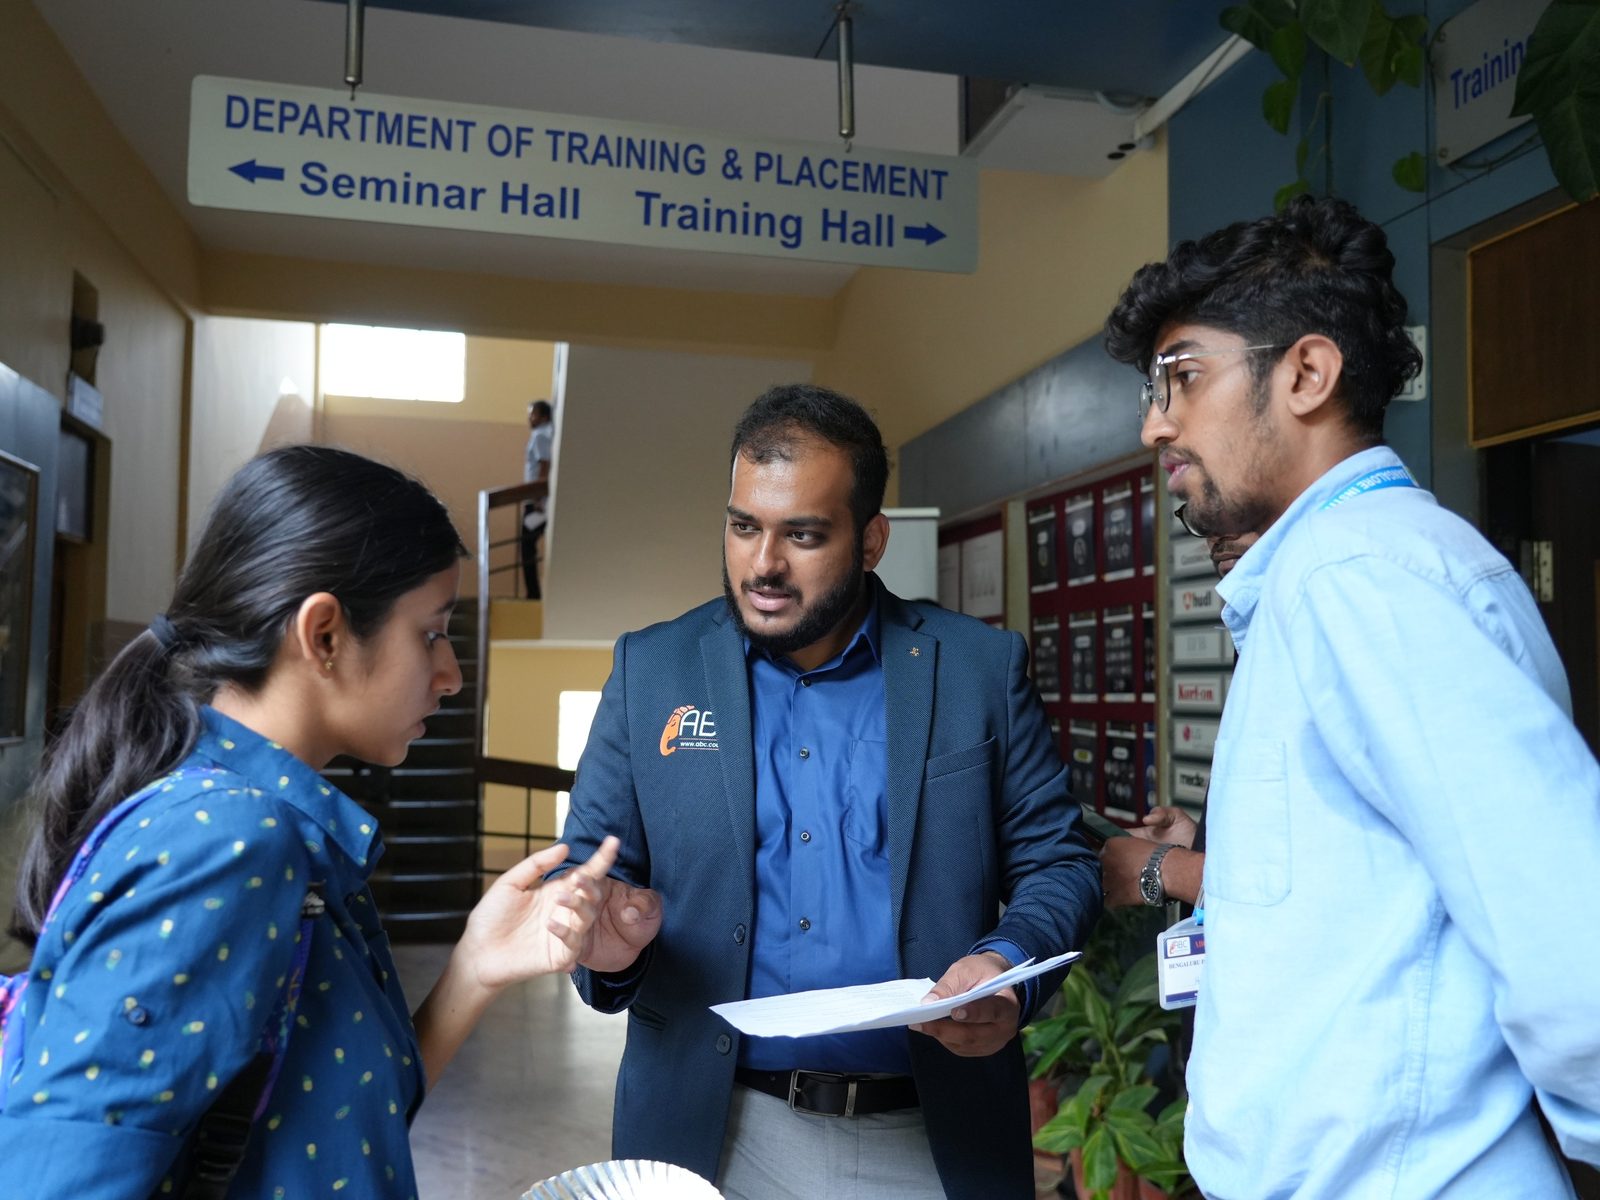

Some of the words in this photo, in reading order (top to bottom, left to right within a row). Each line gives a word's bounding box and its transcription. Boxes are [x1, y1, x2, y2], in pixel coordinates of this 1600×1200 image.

[225, 94, 478, 155] DEPARTMENT
[487, 124, 533, 159] OF
[547, 130, 708, 177] TRAINING
[722, 148, 744, 181] &
[755, 152, 949, 201] PLACEMENT
[299, 160, 486, 212] Seminar
[500, 183, 581, 220] Hall
[635, 190, 803, 249] Training
[819, 208, 895, 248] Hall
